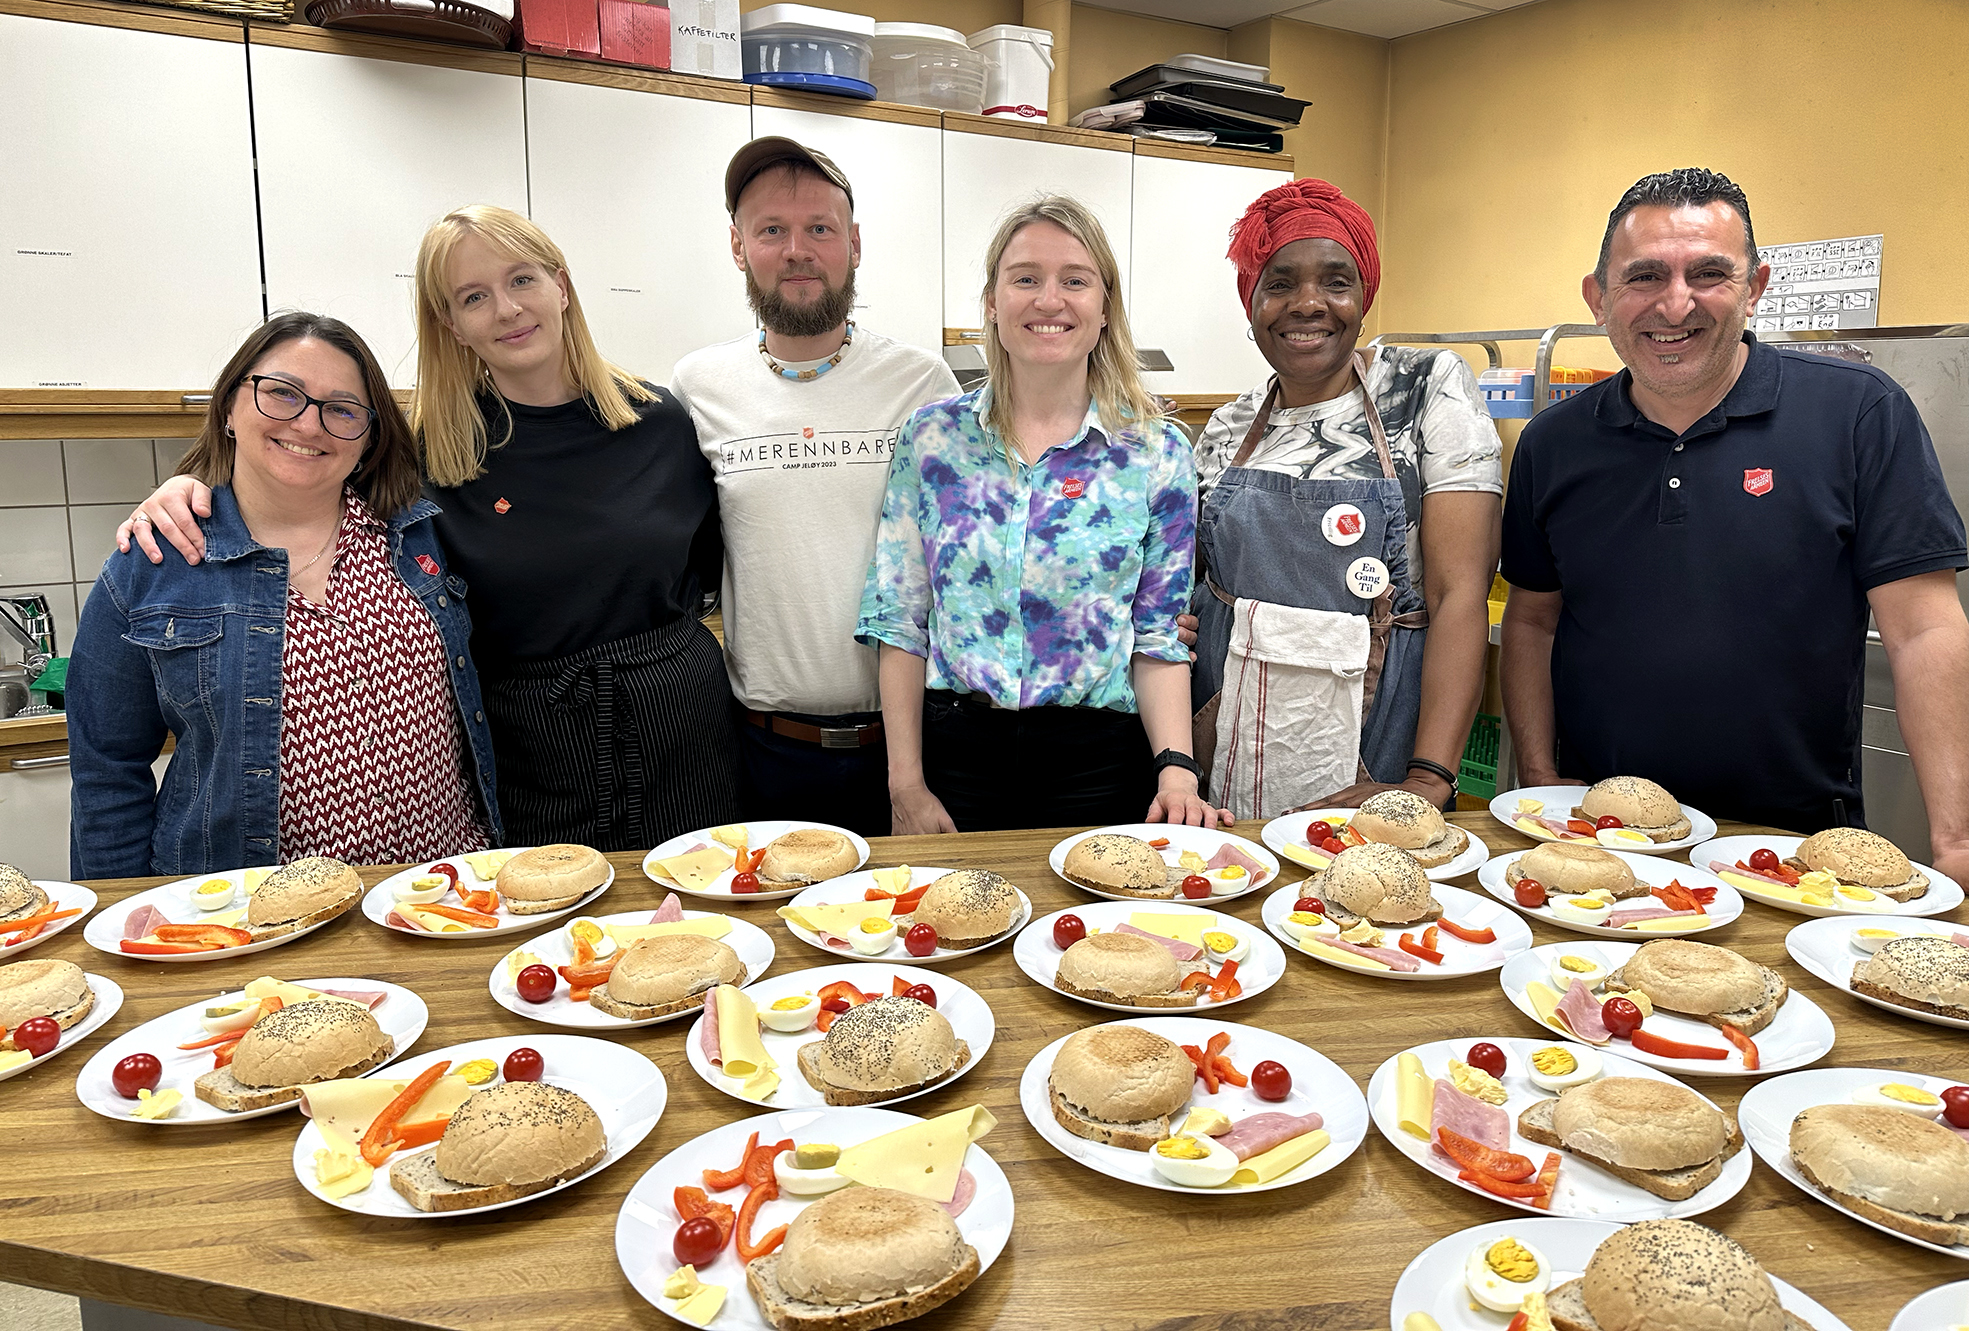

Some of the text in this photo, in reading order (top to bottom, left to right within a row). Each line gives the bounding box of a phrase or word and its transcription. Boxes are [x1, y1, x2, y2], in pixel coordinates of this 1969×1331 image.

[1020, 105, 1036, 116] Lerum
[1362, 563, 1375, 573] En
[1354, 571, 1380, 585] Gang
[1358, 583, 1373, 592] Til
